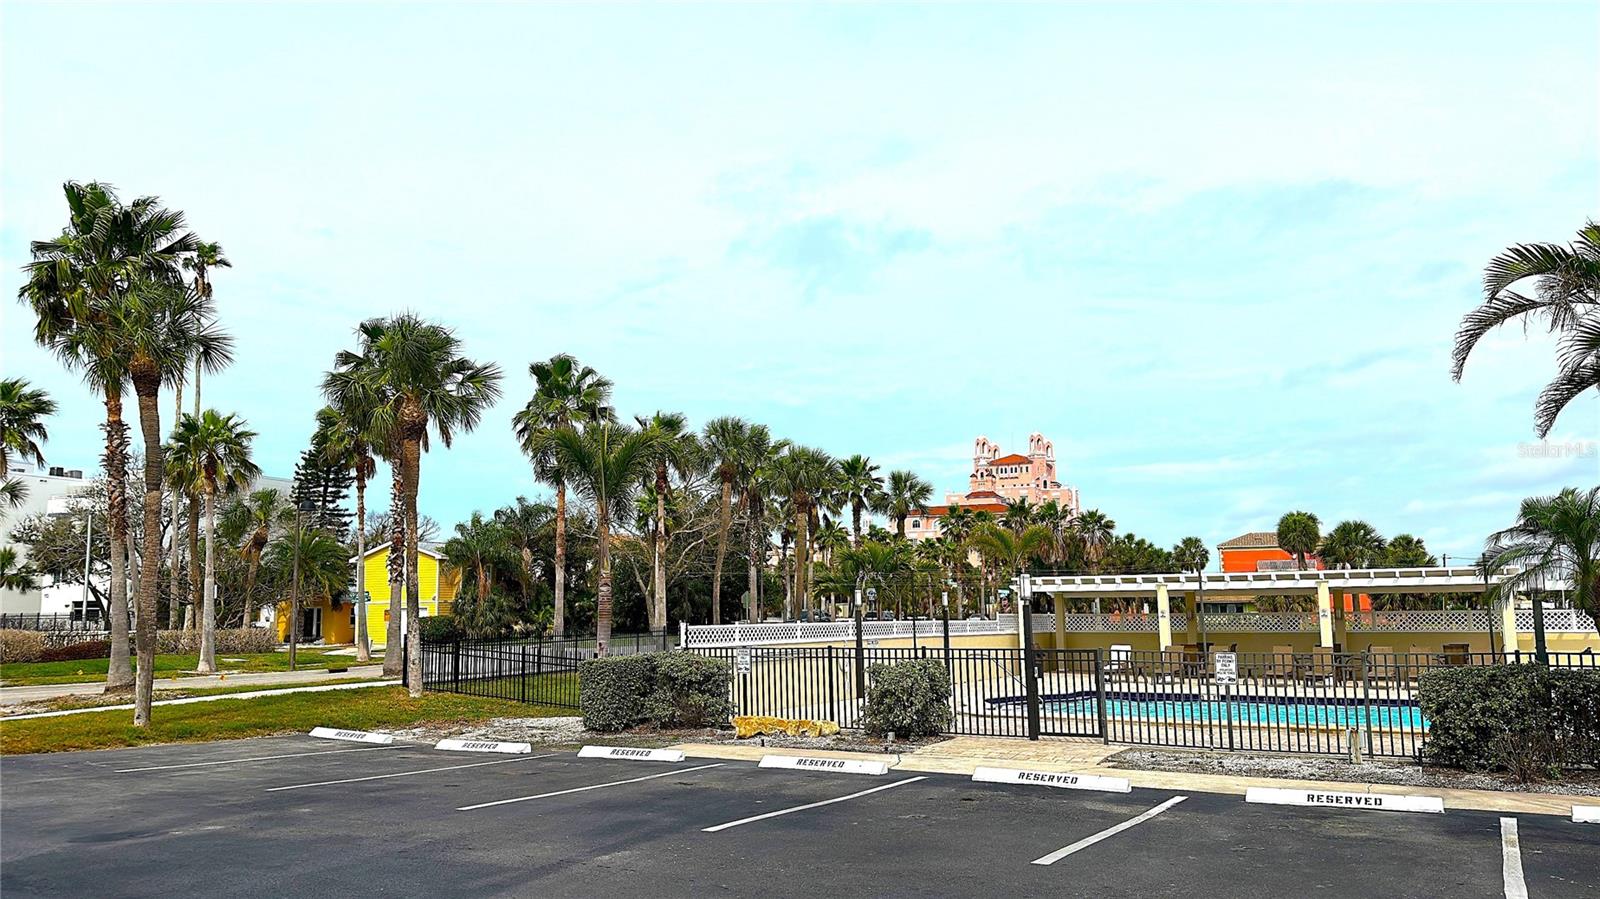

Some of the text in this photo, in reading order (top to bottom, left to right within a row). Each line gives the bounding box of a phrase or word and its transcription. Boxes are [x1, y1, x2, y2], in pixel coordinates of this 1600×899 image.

[334, 731, 367, 740] RESERVED
[461, 741, 499, 750] RESERVED
[610, 748, 652, 757] RESERVED
[796, 758, 845, 768] RESERVED
[1018, 772, 1079, 785] RESERVED
[1307, 793, 1383, 806] RESERVED
